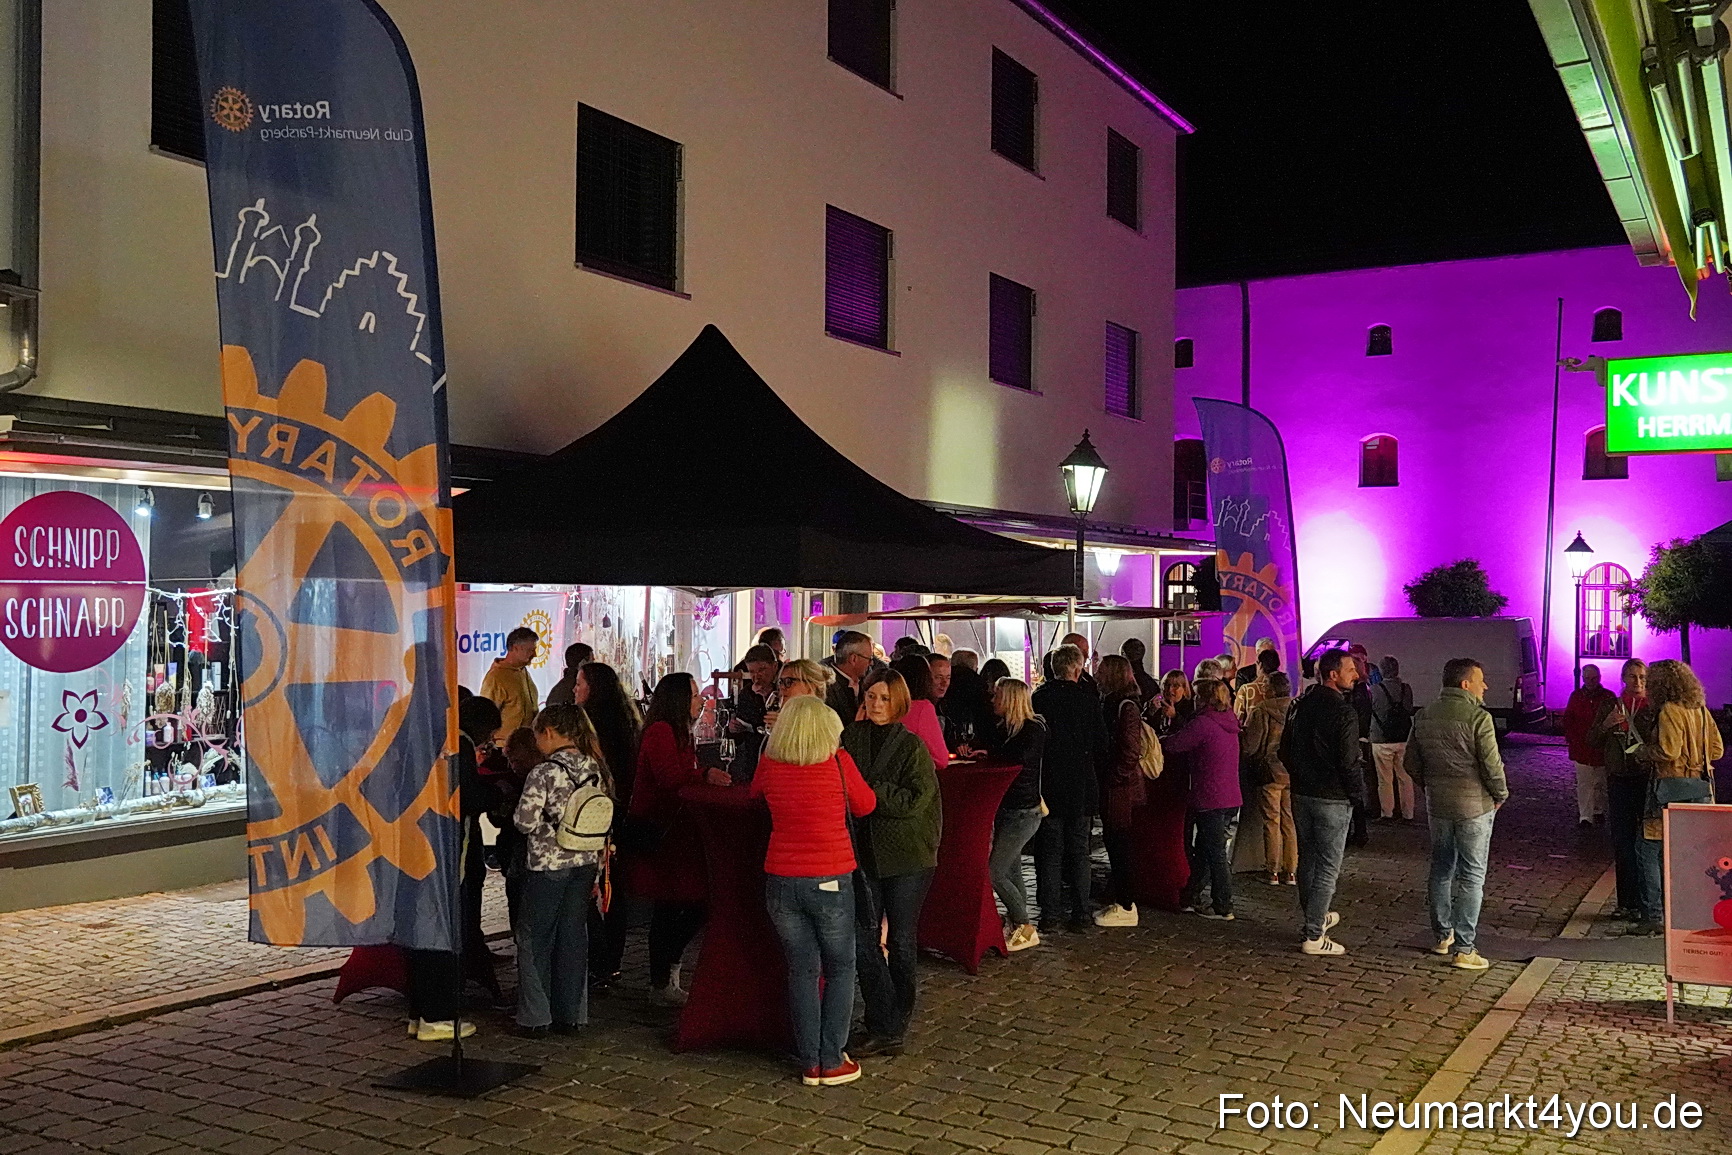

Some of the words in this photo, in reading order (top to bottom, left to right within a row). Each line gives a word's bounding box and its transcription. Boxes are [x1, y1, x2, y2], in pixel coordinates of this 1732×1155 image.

[1638, 412, 1732, 438] HERRM
[14, 525, 120, 569] SCHNIPP
[5, 597, 125, 639] SCHNAPP
[457, 630, 507, 657] otary
